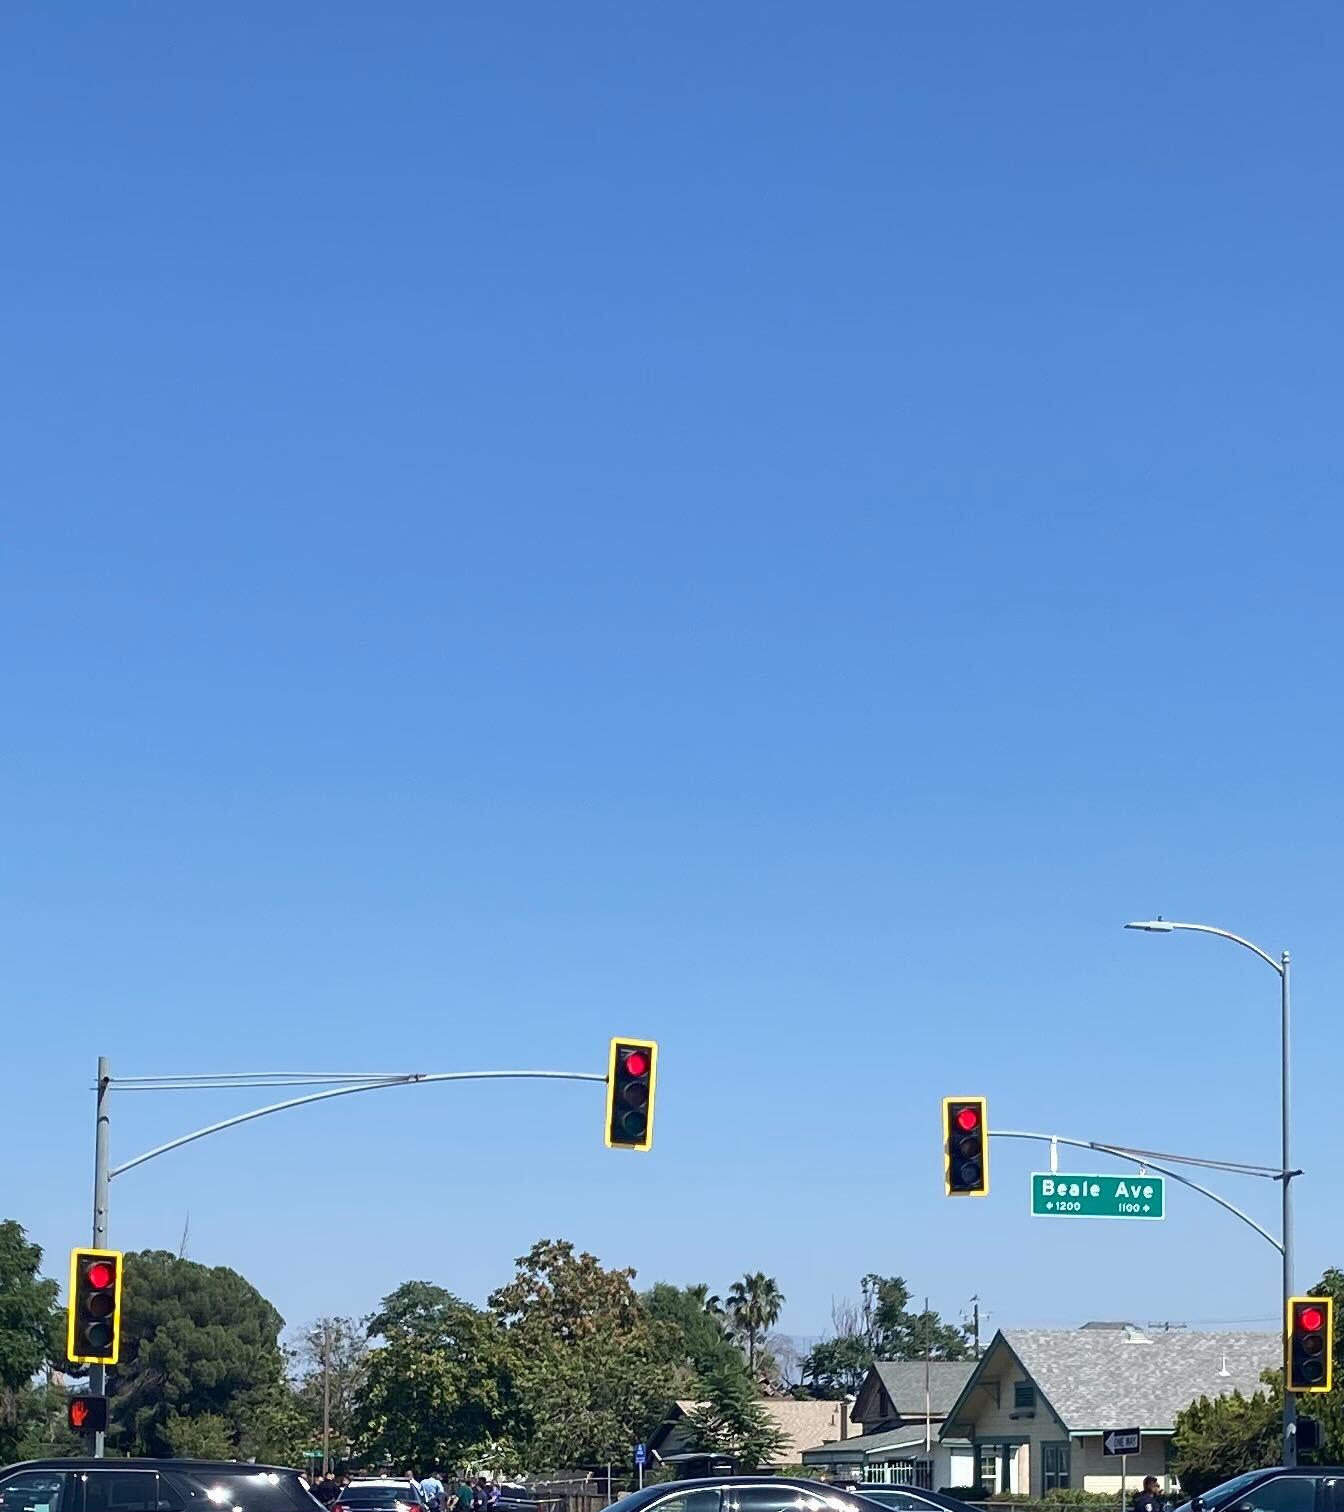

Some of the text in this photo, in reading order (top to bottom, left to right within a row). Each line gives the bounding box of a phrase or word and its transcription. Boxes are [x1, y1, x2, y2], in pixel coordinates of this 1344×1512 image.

[1042, 1179, 1154, 1199] Beale Ave
[1055, 1201, 1081, 1211] 1200
[1118, 1202, 1140, 1213] 1100
